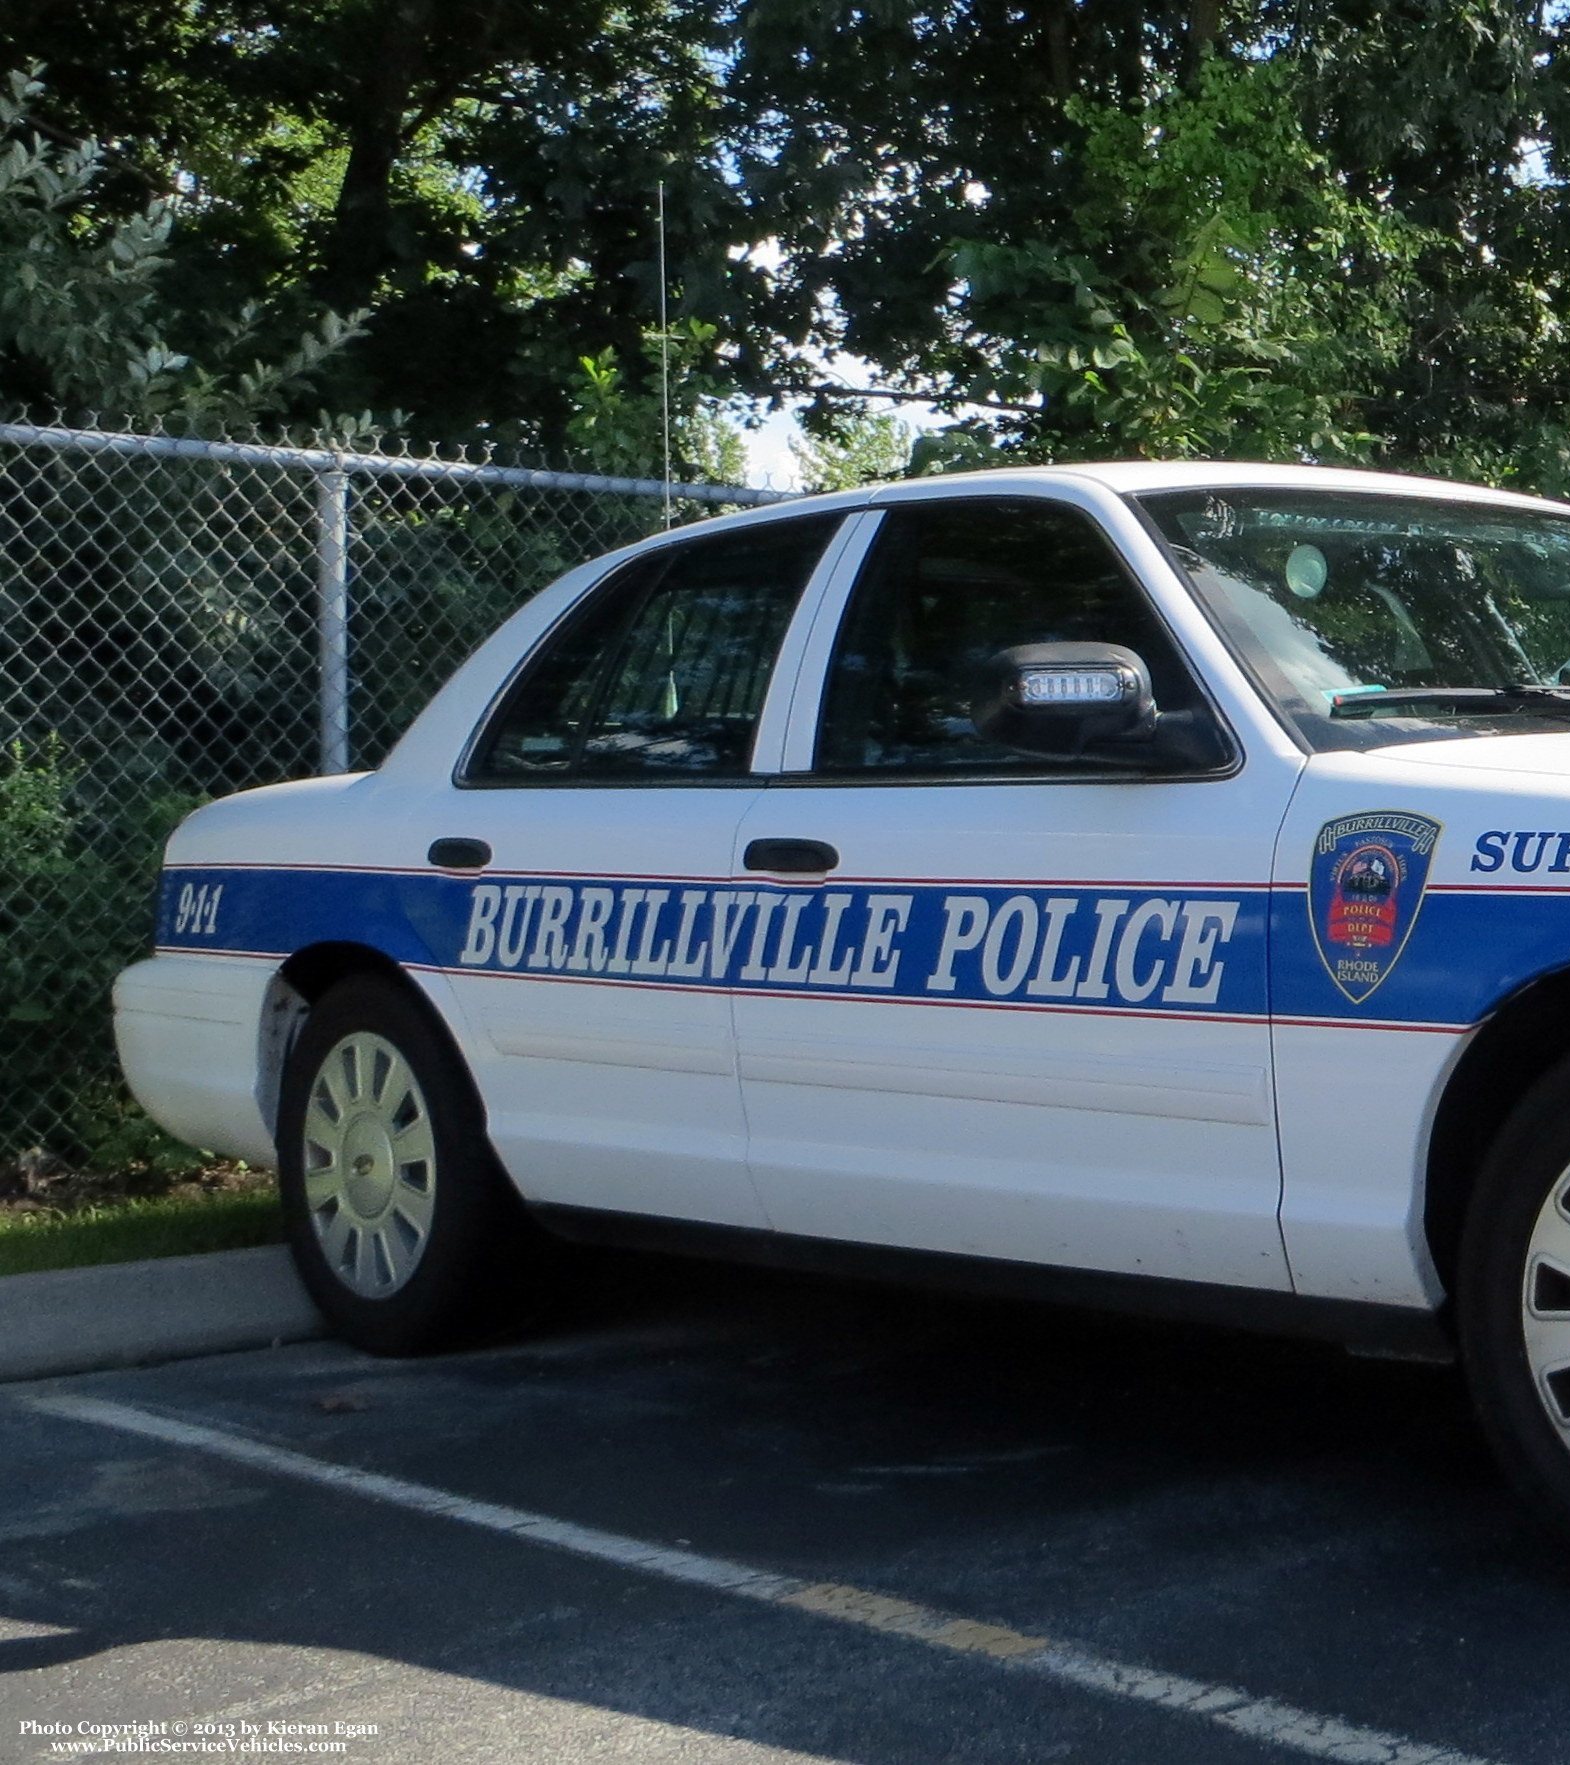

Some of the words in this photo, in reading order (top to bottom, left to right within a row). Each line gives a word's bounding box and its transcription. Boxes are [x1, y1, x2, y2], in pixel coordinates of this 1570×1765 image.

[1335, 816, 1427, 838] BURRILLVILLE
[460, 884, 915, 989] BURRILLVILLE
[926, 894, 1241, 1005] POLICE
[1337, 959, 1379, 972] RHODE
[1337, 970, 1379, 983] ISLAND
